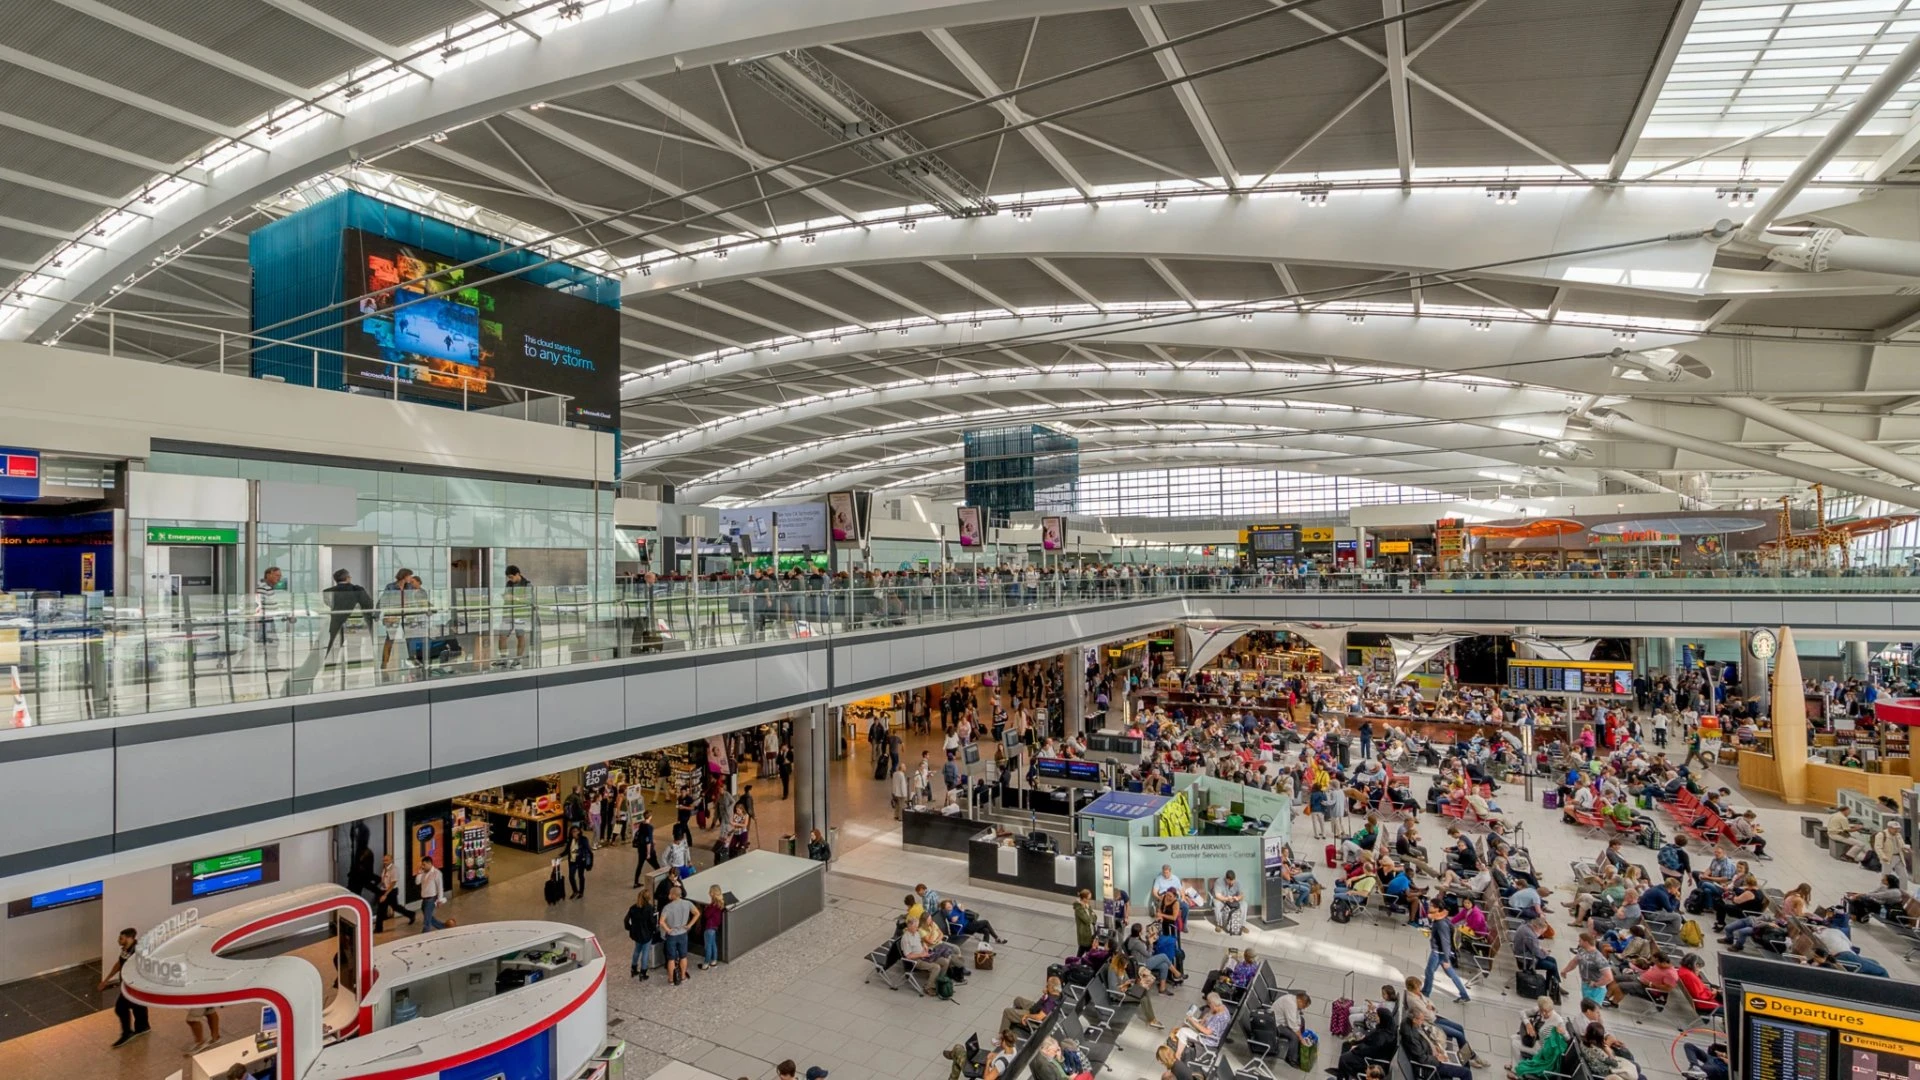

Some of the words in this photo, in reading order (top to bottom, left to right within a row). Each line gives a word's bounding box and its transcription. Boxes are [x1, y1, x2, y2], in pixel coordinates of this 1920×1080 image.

[524, 334, 537, 344] This
[537, 338, 554, 349] cloud
[524, 344, 537, 357] to
[540, 349, 560, 366] any
[562, 353, 596, 371] storm.
[167, 533, 207, 542] Emergency
[591, 766, 608, 778] FOR
[1170, 843, 1199, 851] BRITISH
[1200, 843, 1231, 851] AIRWAYS
[1170, 851, 1200, 859] Customer
[1202, 851, 1228, 859] Services
[1771, 1000, 1864, 1026] Departures
[1856, 1037, 1896, 1050] Terminal
